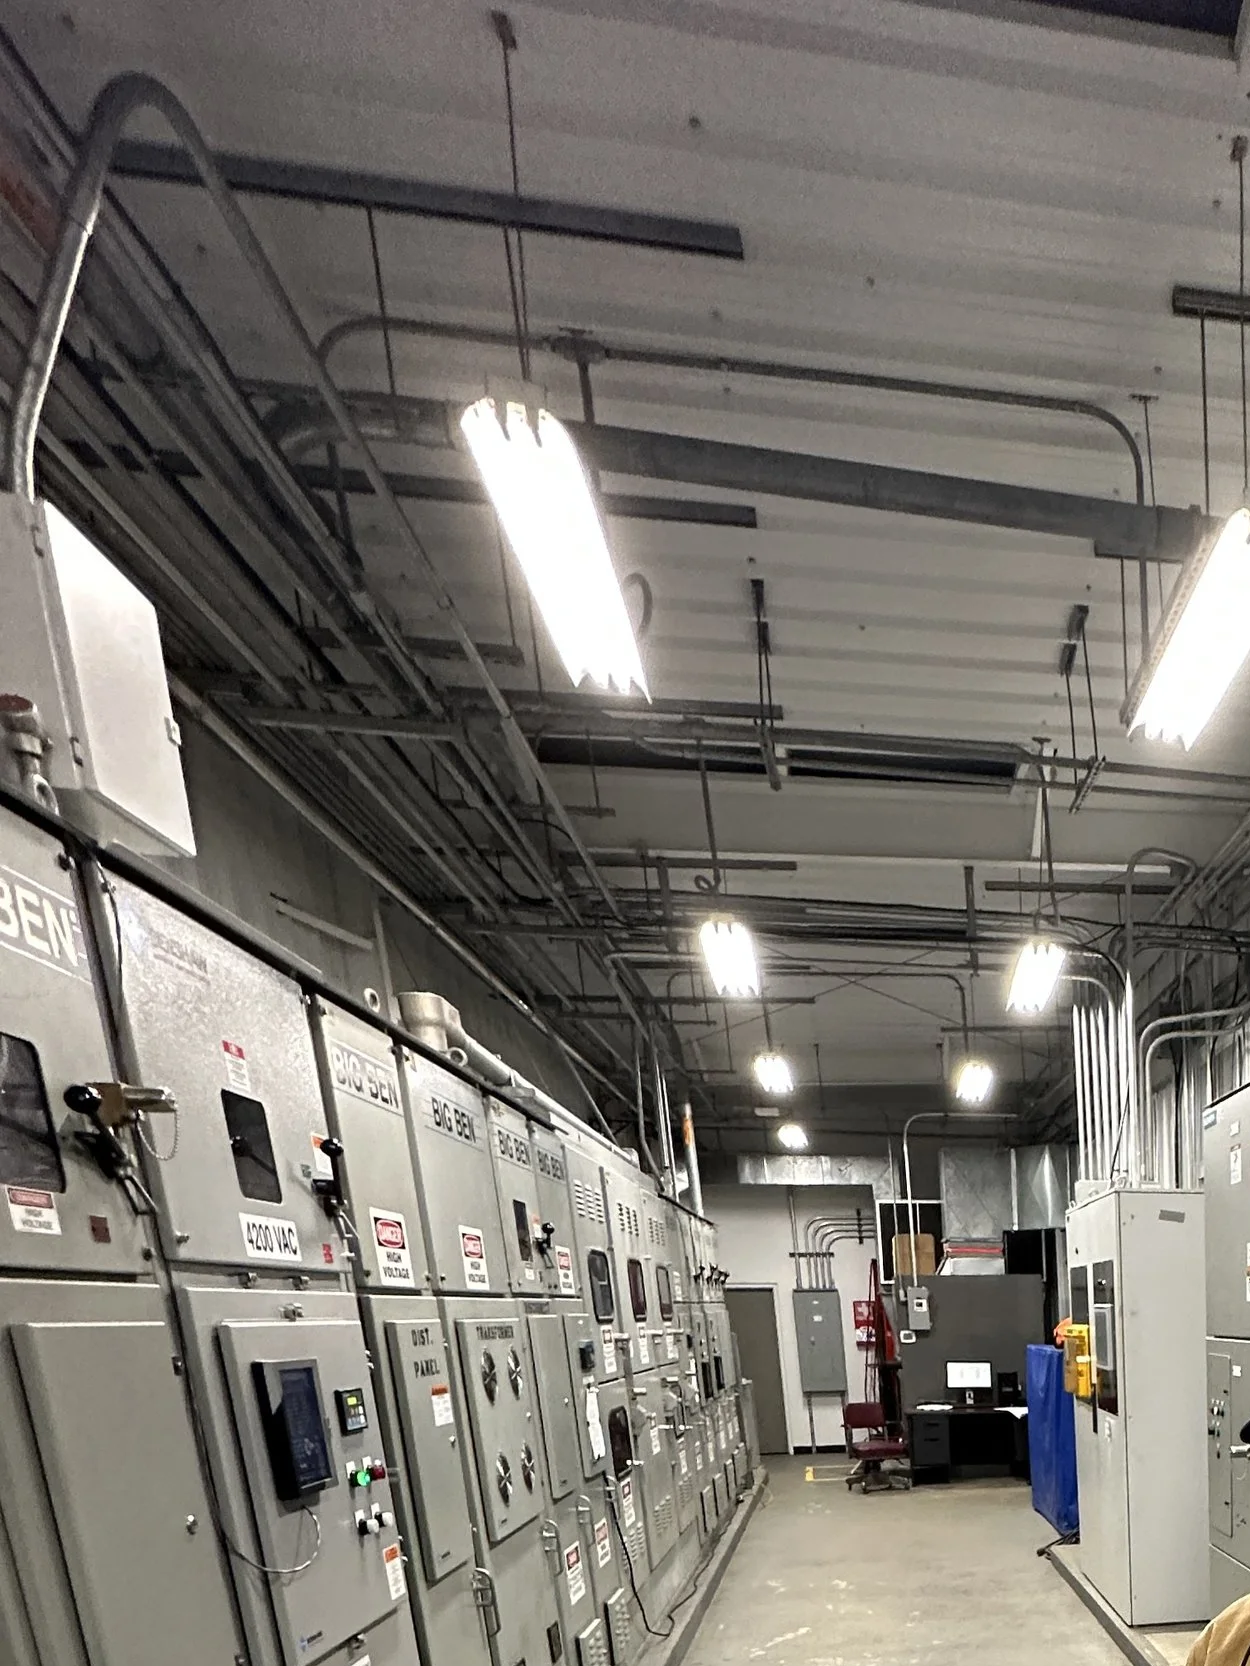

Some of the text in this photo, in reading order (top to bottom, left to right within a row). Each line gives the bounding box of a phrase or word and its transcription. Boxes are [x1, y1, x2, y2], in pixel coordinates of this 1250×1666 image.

[332, 1047, 364, 1093] BIG
[431, 1096, 476, 1143] BIG BEN
[498, 1129, 530, 1166] BIG BEN
[246, 1221, 298, 1255] 4200 VAC
[411, 1327, 434, 1346] DIST.
[476, 1324, 514, 1340] TRANSFORMER
[413, 1358, 440, 1378] PANEL
